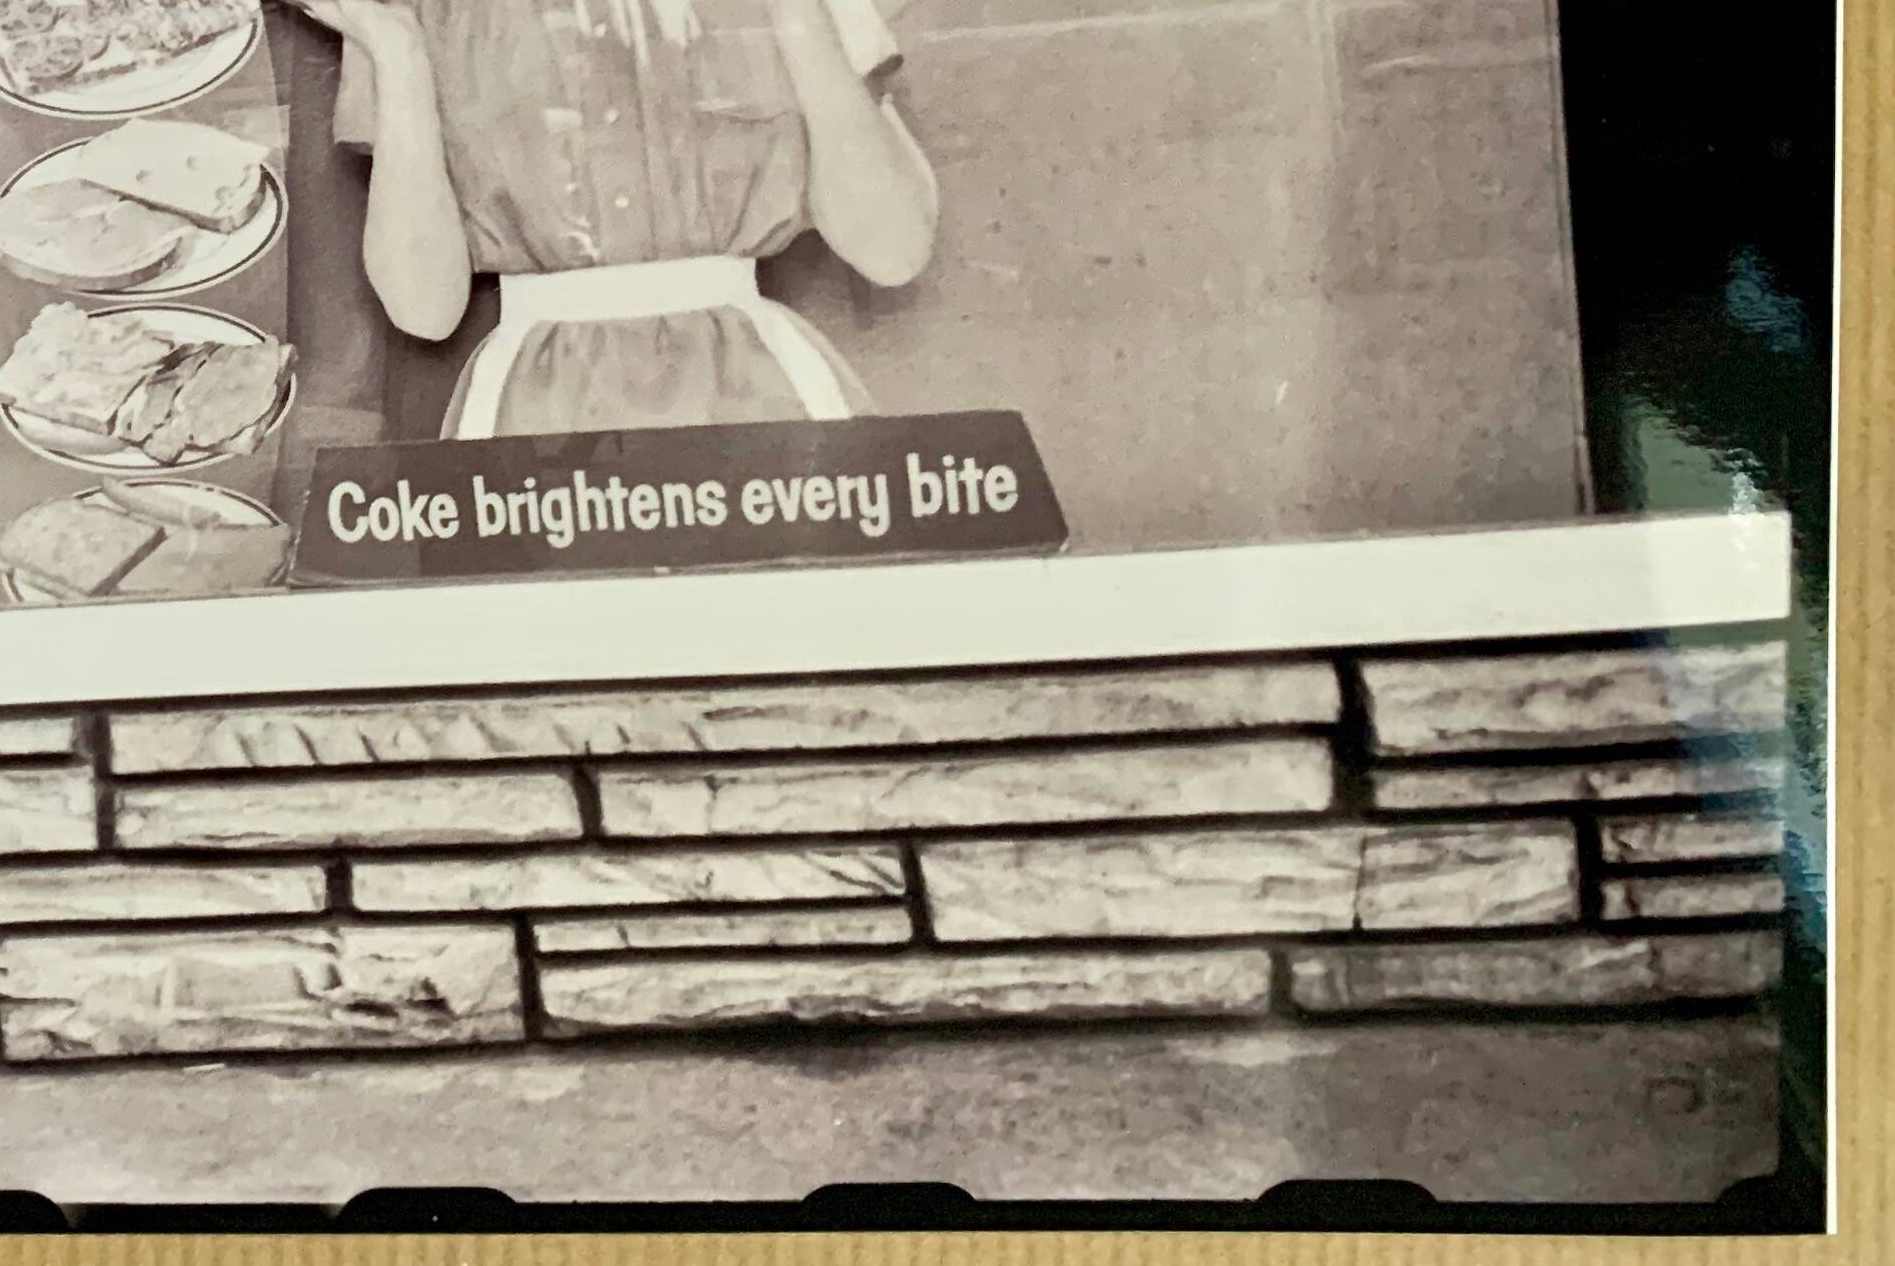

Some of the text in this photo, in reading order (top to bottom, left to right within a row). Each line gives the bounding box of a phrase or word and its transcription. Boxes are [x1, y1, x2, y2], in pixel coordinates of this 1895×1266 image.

[328, 453, 1019, 549] Coke brightens every bite
